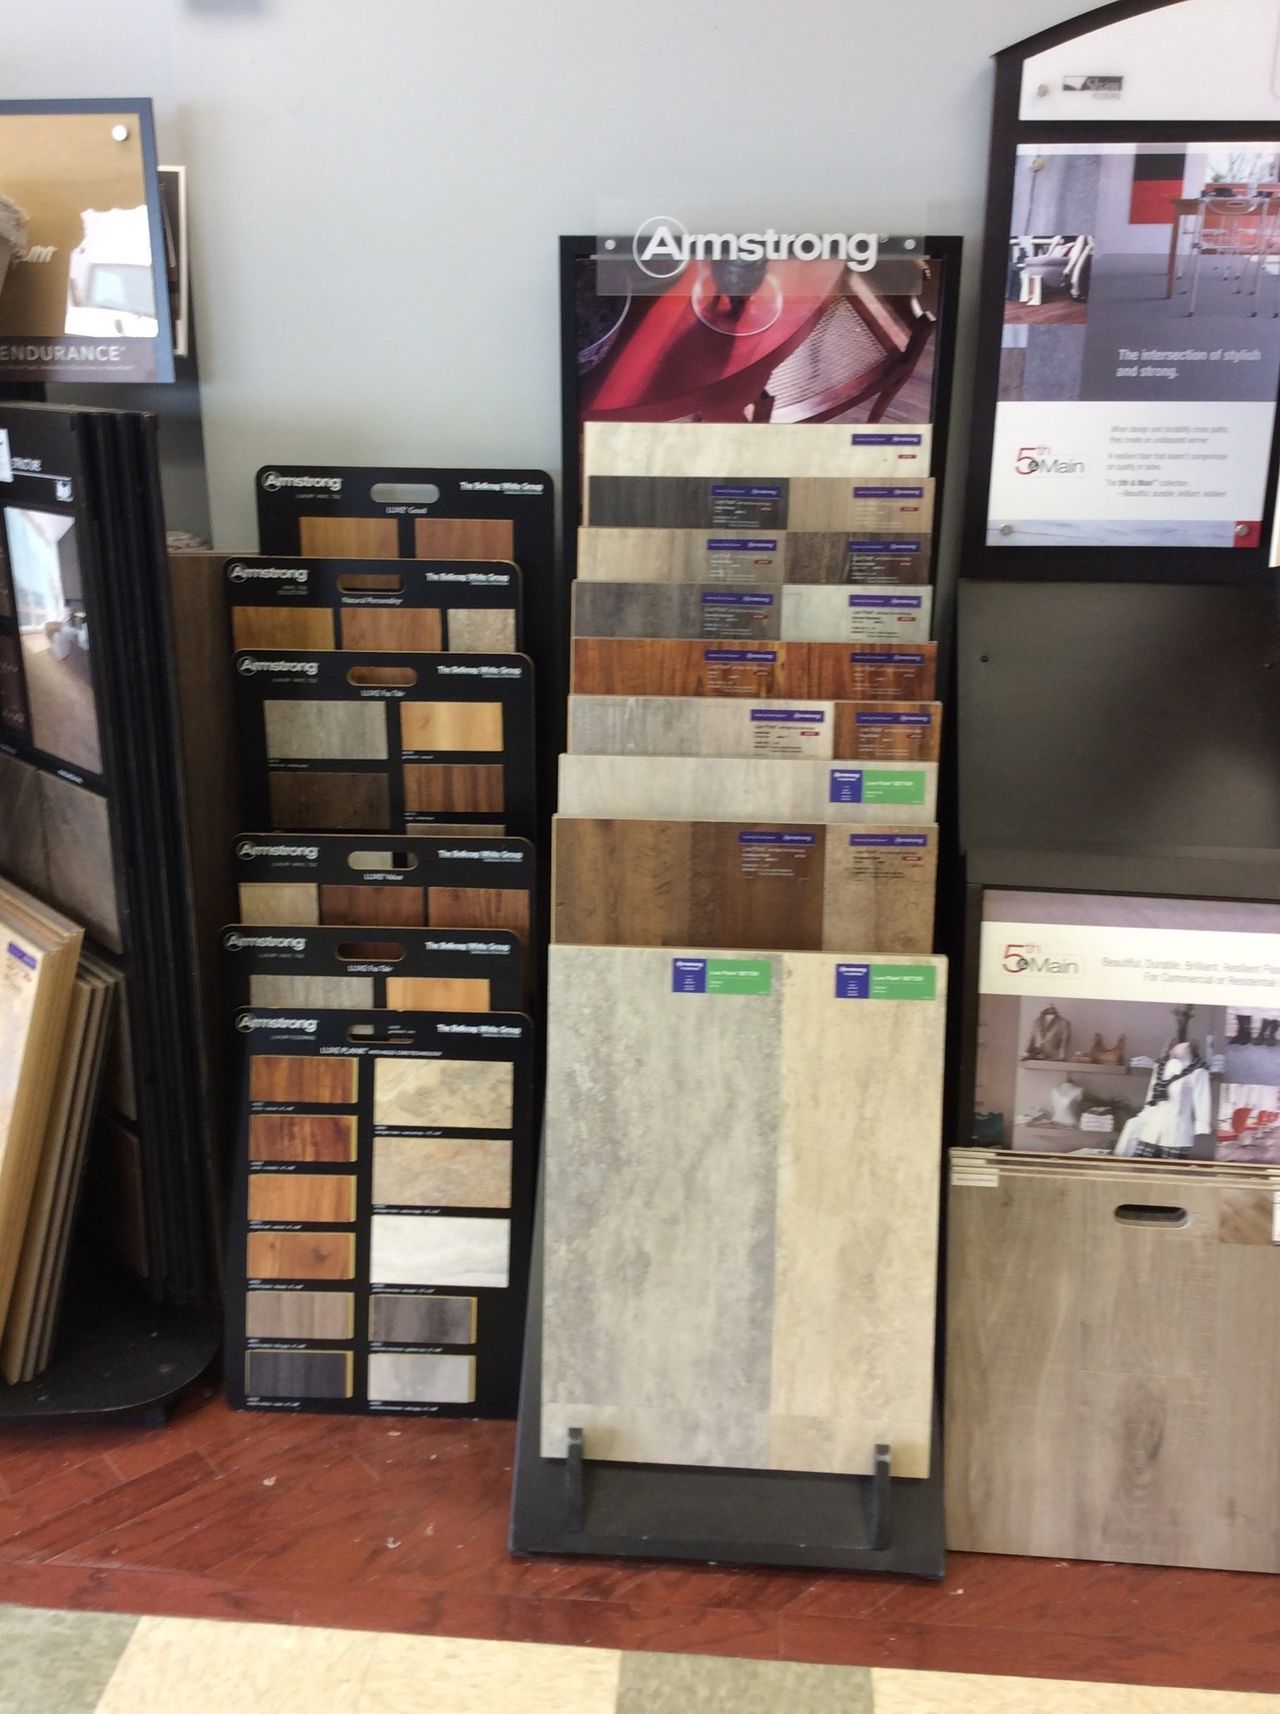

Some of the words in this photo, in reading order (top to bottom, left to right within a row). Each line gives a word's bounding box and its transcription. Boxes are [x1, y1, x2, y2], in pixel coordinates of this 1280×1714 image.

[633, 216, 879, 278] Armstrong
[1039, 459, 1085, 474] Main
[261, 471, 342, 492] Armstrong
[228, 563, 309, 583] Armstrong
[237, 656, 319, 677] Armstrong
[238, 840, 320, 861] Armstrong
[223, 932, 306, 952] Armstrong
[1029, 958, 1079, 974] Main
[236, 1013, 318, 1034] Armstrong
